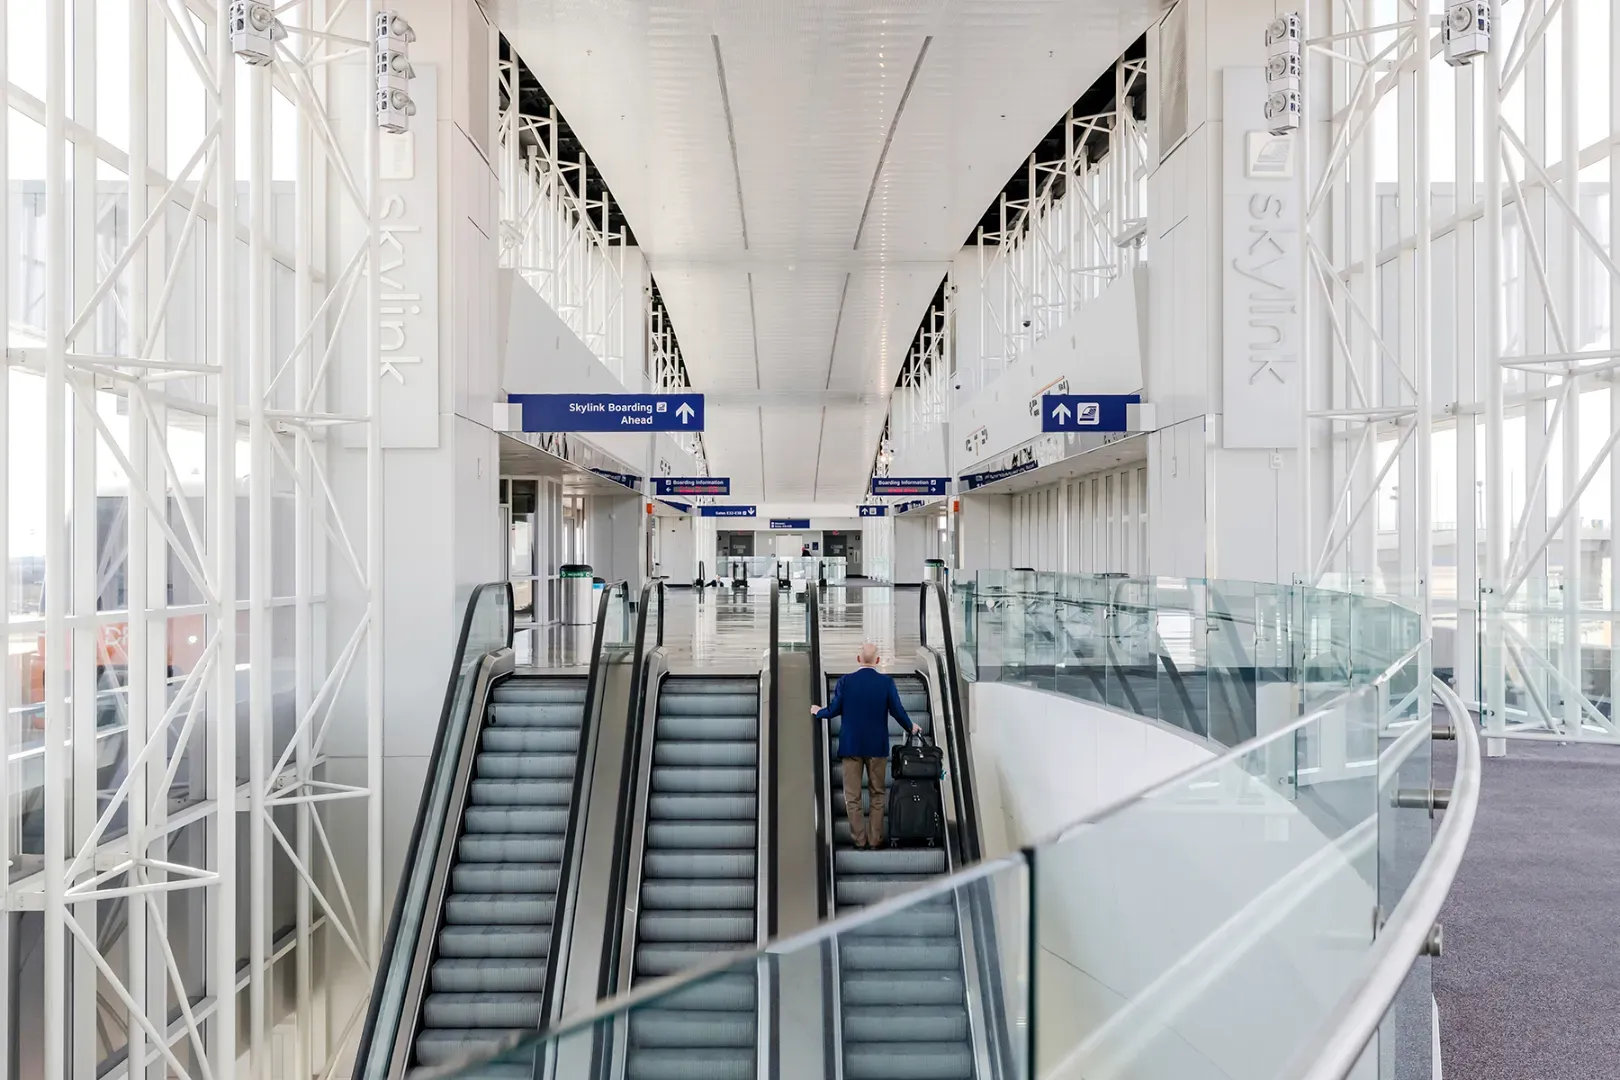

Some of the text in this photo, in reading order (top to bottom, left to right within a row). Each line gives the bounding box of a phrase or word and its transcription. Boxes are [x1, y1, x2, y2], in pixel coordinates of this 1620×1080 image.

[364, 193, 423, 385] skylink
[1232, 192, 1298, 386] skylink
[569, 402, 653, 414] Skylink Boarding
[621, 415, 653, 425] Ahead
